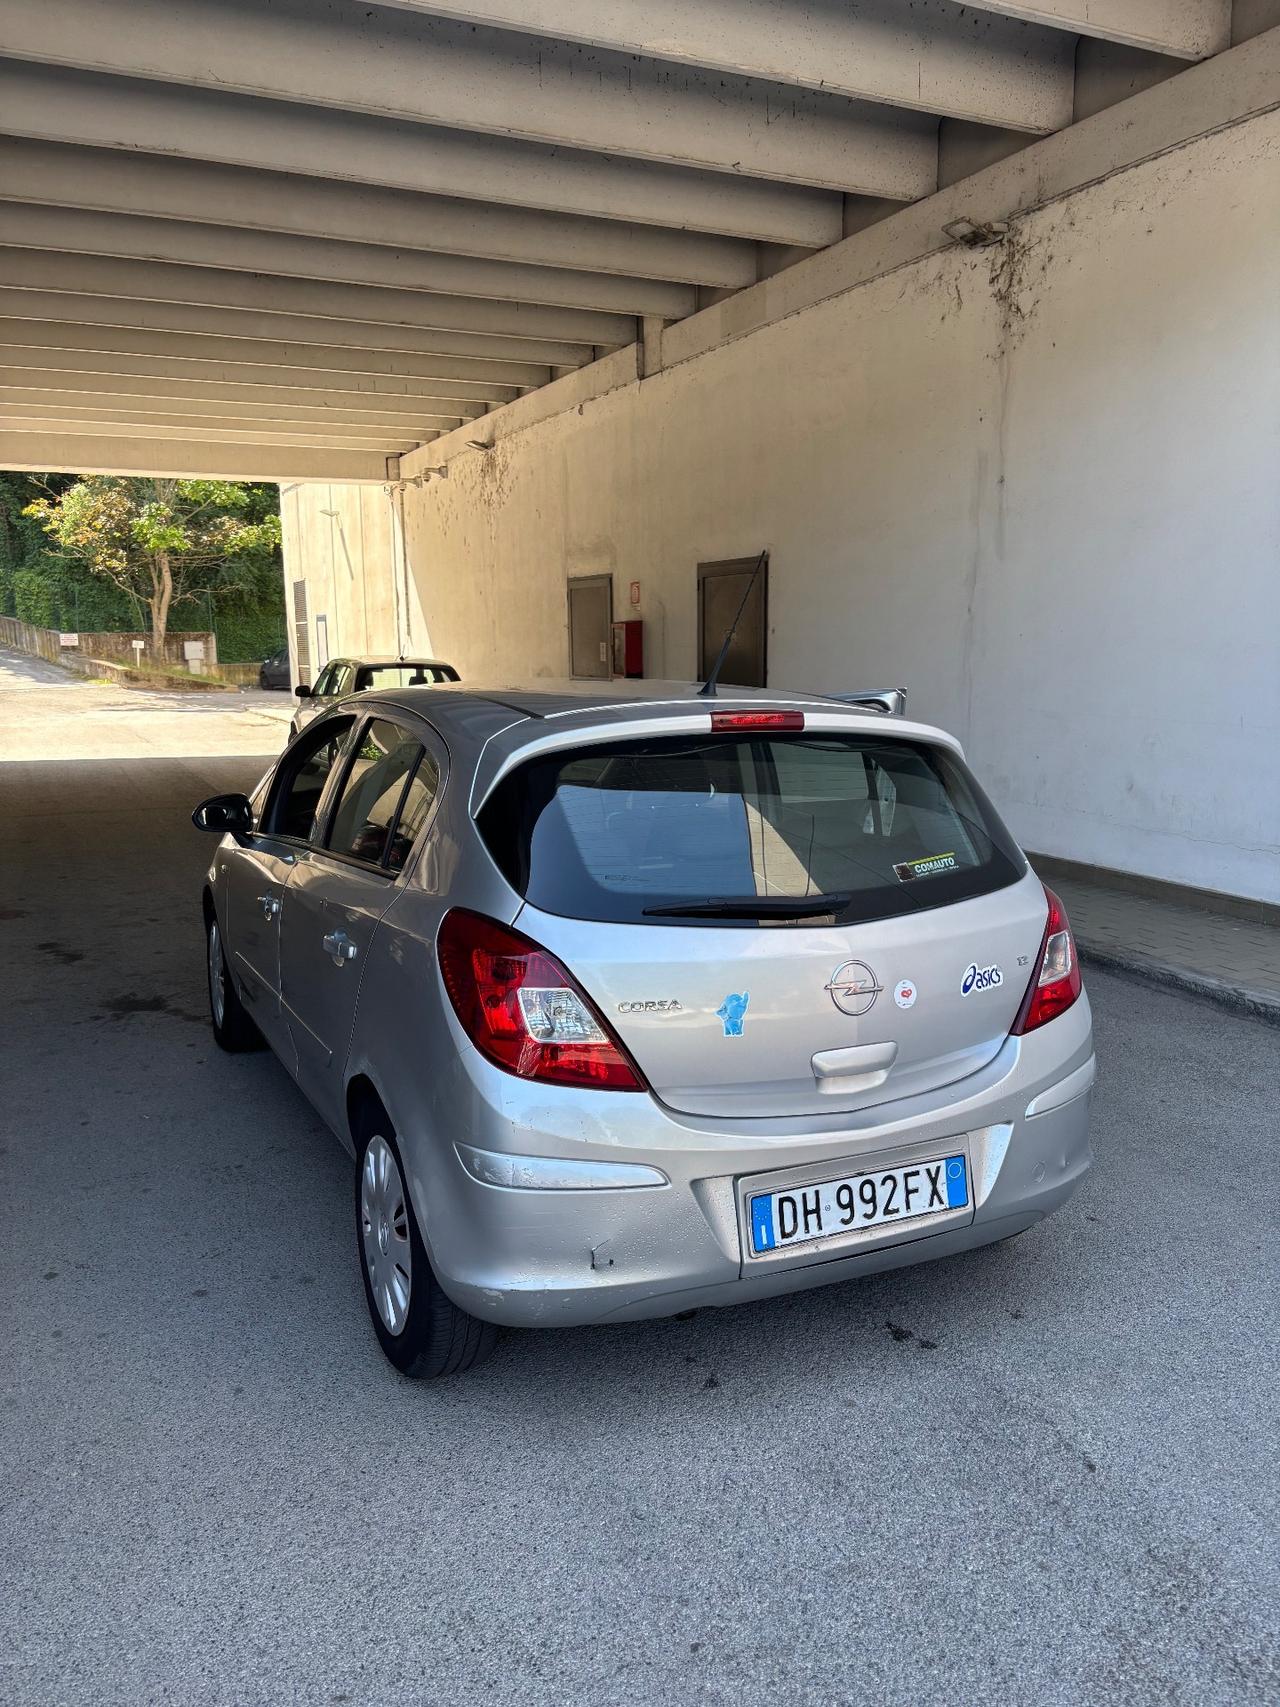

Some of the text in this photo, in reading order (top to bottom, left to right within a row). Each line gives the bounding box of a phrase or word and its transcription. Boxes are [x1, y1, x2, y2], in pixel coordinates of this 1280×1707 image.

[914, 857, 955, 873] COMAUTO
[617, 999, 683, 1014] CORSA
[778, 1189, 823, 1239] DH
[836, 1165, 945, 1226] 992FX
